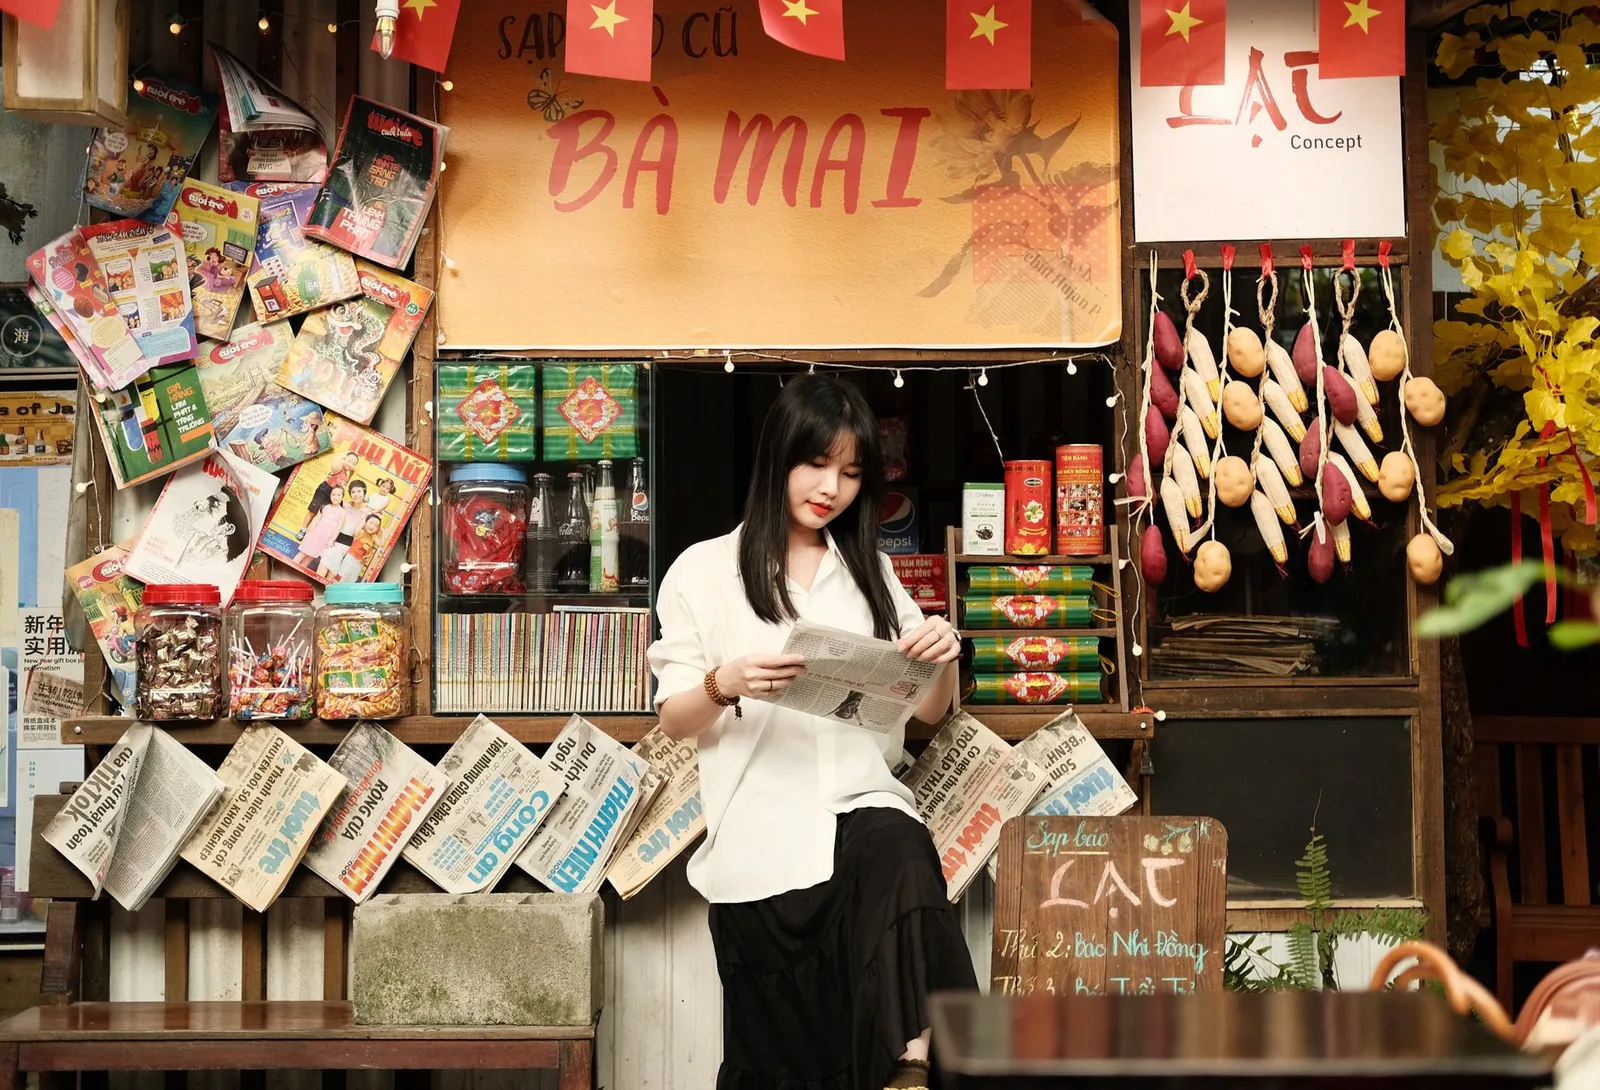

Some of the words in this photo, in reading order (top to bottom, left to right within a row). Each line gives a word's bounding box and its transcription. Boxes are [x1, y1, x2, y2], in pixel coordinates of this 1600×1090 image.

[497, 13, 565, 65] SẠP
[682, 6, 738, 59] CŨ
[545, 85, 679, 216] BÀ
[713, 107, 931, 214] MAI
[1290, 133, 1363, 152] Concept
[16, 402, 42, 415] of
[878, 536, 913, 550] pepsi
[24, 614, 64, 634] 新年
[24, 636, 80, 656] 实用
[112, 746, 136, 768] của
[579, 741, 597, 762] Du
[952, 756, 971, 776] nên
[965, 744, 981, 759] Có
[258, 763, 286, 799] Thanh
[462, 753, 492, 784] nhưng
[564, 755, 588, 784] lịch
[940, 773, 959, 793] thu
[63, 760, 122, 823] TikTok
[346, 778, 372, 809] khách
[354, 777, 390, 818] RỘNG
[445, 779, 470, 805] chưa
[924, 789, 948, 815] thuế
[83, 794, 118, 828] thuật
[241, 796, 265, 826] niên:
[370, 776, 434, 851] THANH
[490, 786, 553, 857] Công
[583, 775, 634, 850] THANH
[64, 823, 93, 851] toán
[340, 814, 369, 844] CỬA
[418, 821, 437, 839] đã
[1074, 821, 1109, 847] báo
[340, 840, 390, 897] NIÊN
[466, 849, 501, 887] an
[550, 838, 601, 896] NIÊN
[998, 929, 1041, 959] Thứ
[1113, 928, 1150, 957] Nhi
[1153, 930, 1208, 974] Đồng
